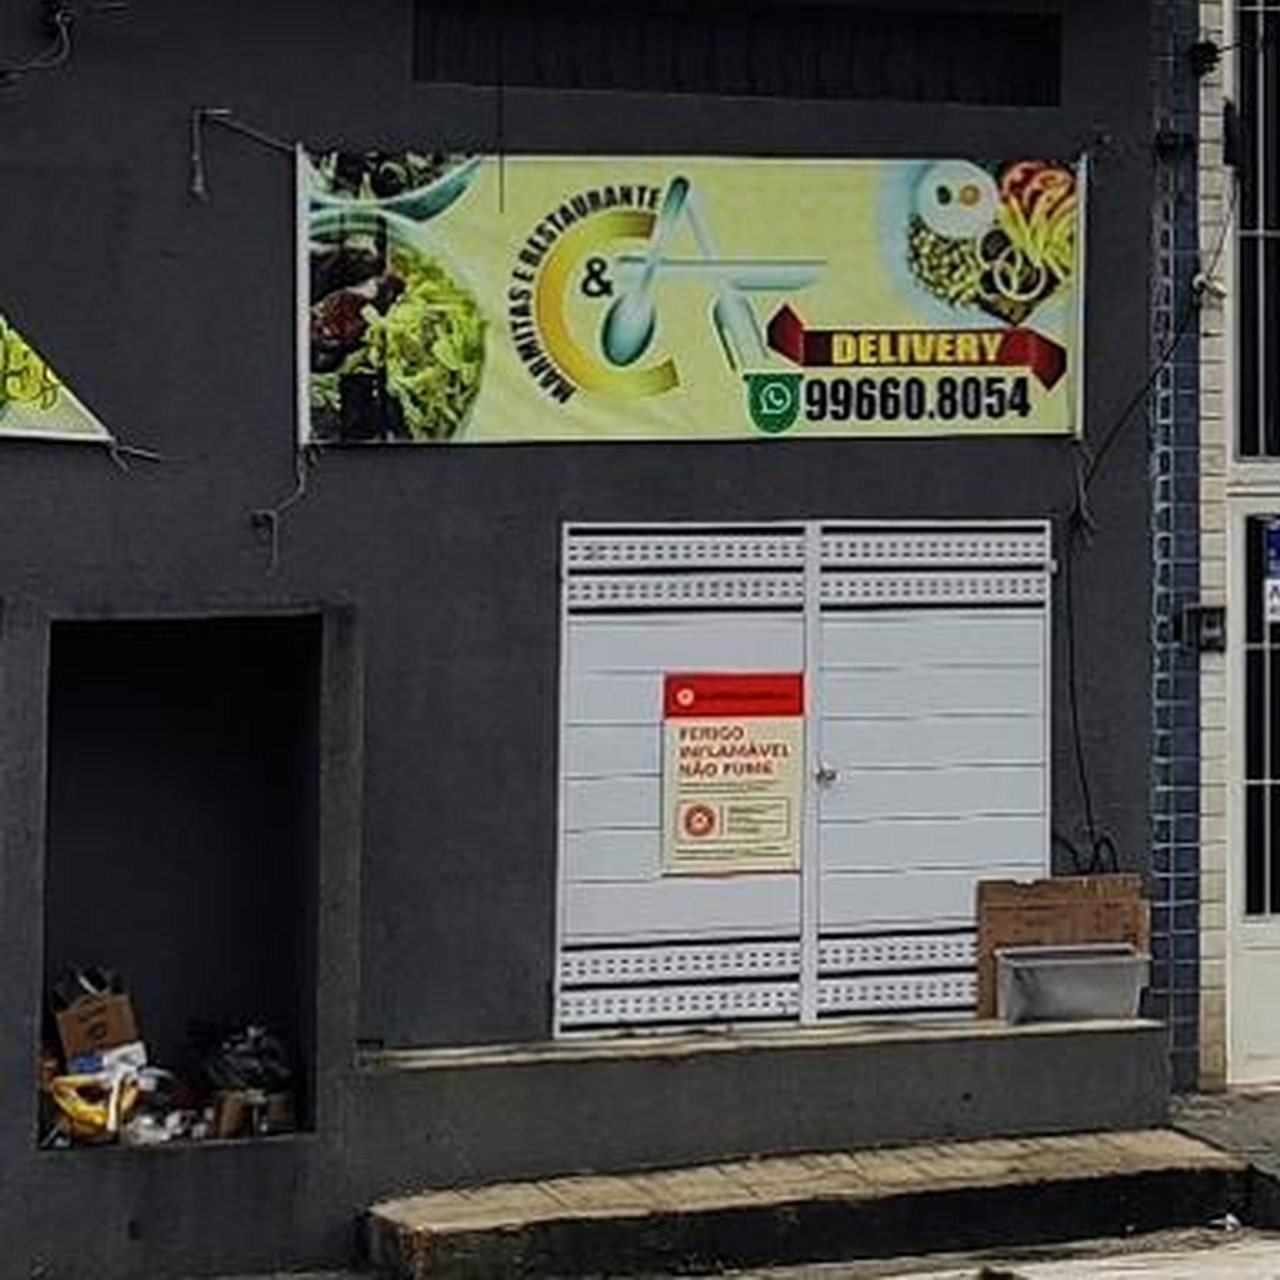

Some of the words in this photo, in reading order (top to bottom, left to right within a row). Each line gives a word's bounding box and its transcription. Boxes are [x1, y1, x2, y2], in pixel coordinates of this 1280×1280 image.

[518, 184, 662, 268] RESTAURANTE
[509, 286, 577, 404] MARMITAS
[831, 332, 1005, 365] DELIVERY
[805, 375, 1032, 421] 99660.8054
